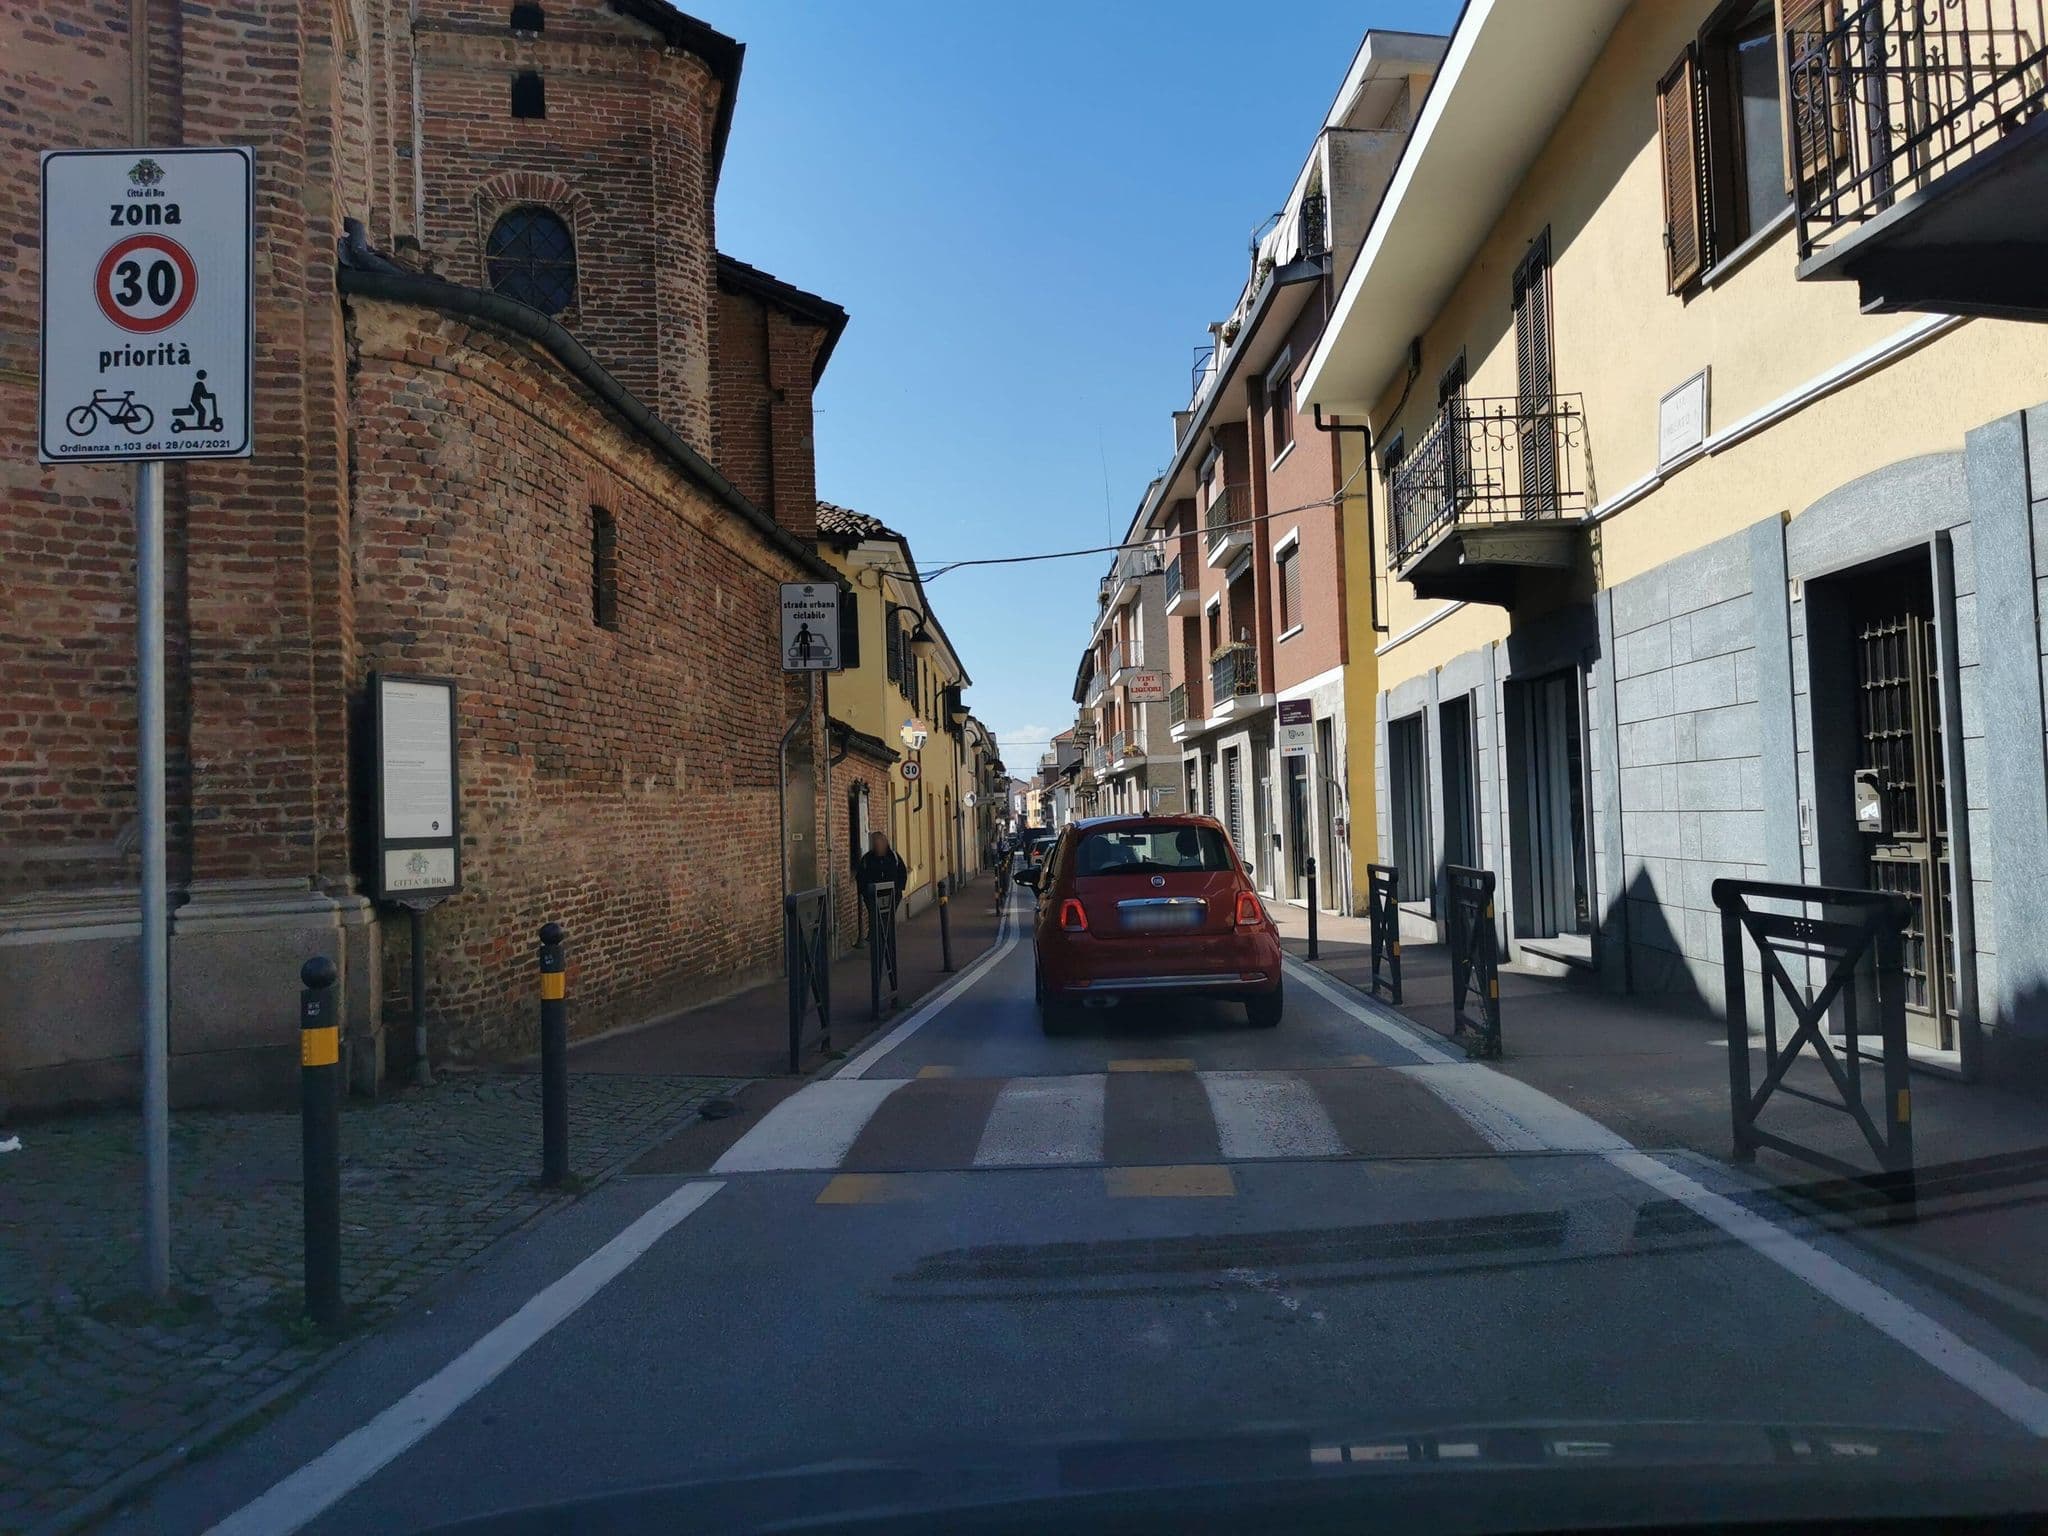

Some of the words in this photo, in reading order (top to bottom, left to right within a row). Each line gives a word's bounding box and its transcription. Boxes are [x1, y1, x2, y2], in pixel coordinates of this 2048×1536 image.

[127, 188, 143, 198] Città
[145, 188, 151, 198] di
[153, 188, 165, 198] Bra
[110, 203, 182, 226] zona
[116, 259, 176, 307] 30
[99, 342, 191, 373] priorità
[60, 443, 111, 453] Ordinanza
[114, 442, 141, 451] n.103
[145, 441, 161, 450] del
[165, 439, 231, 450] 28/04/2021
[784, 600, 808, 609] strada
[810, 600, 835, 608] urbana
[793, 610, 826, 619] ciclabile
[904, 765, 917, 775] 30
